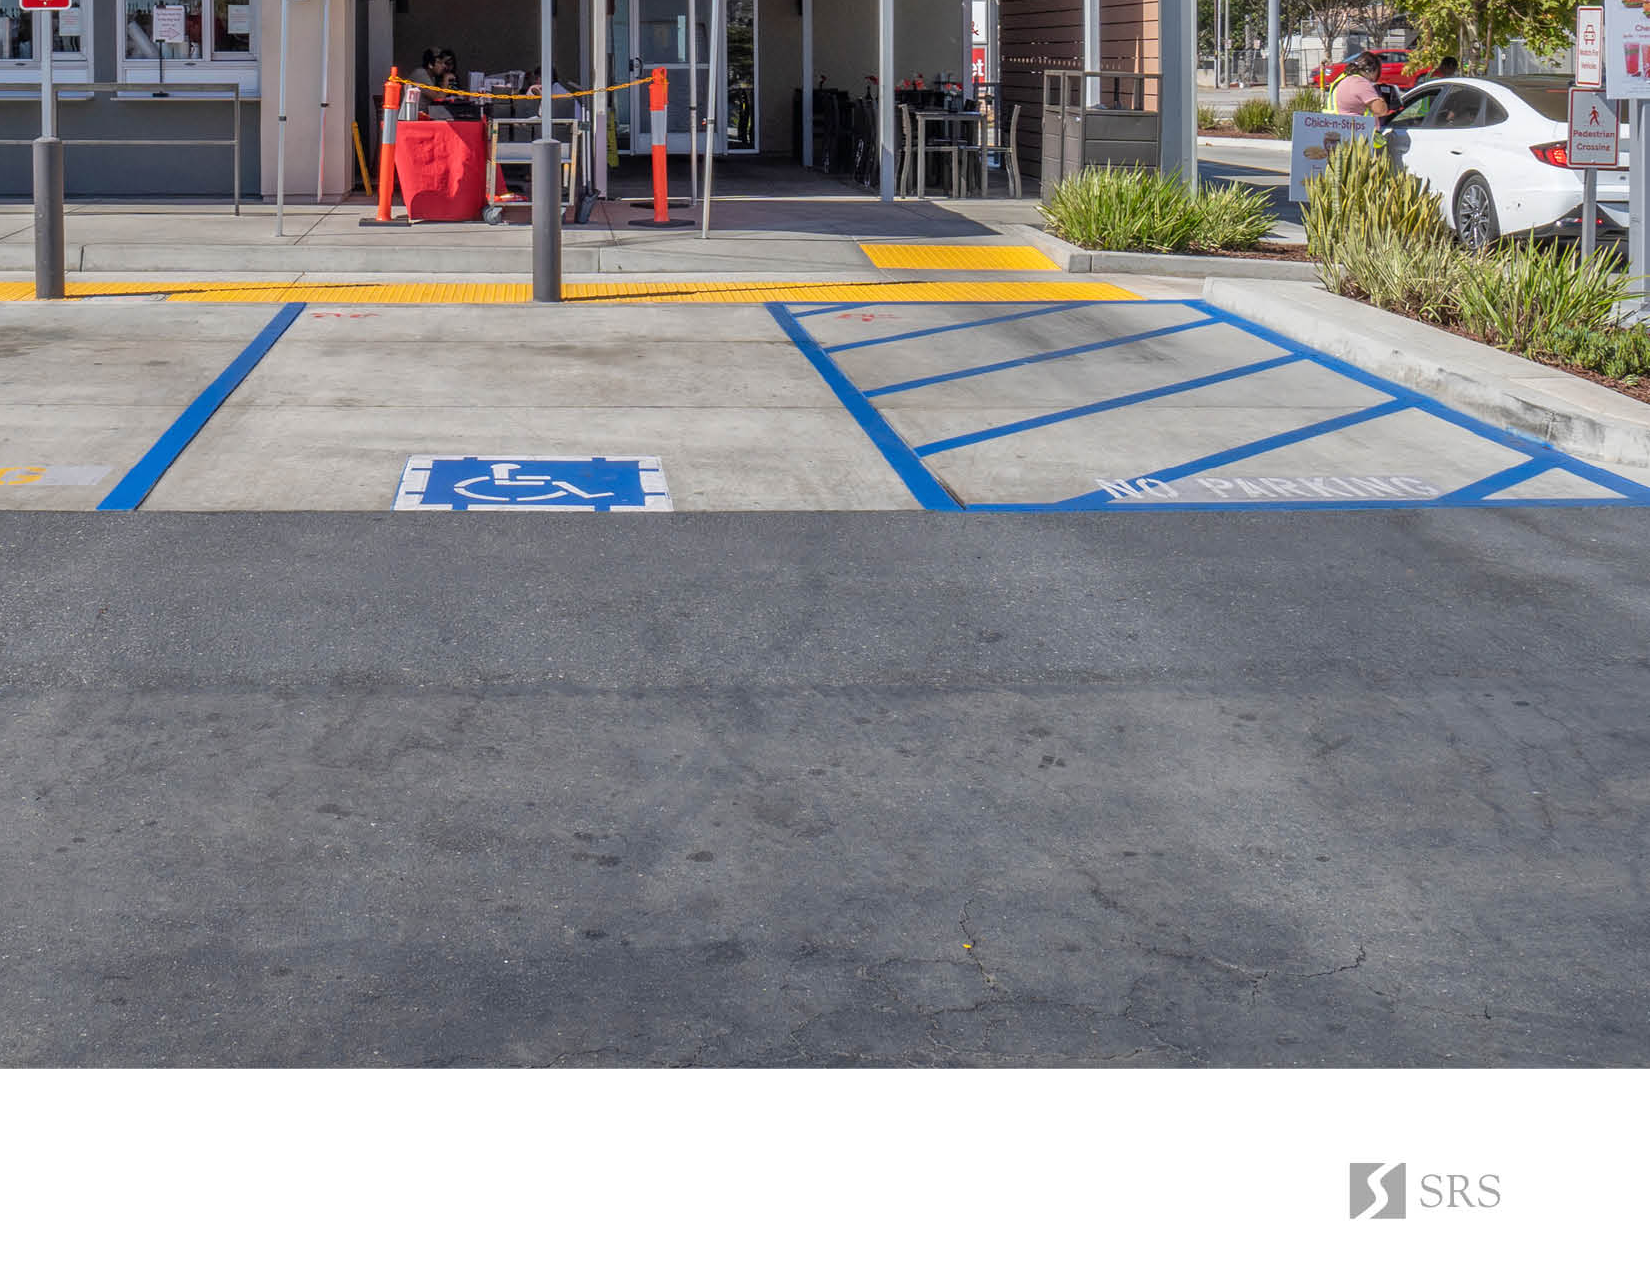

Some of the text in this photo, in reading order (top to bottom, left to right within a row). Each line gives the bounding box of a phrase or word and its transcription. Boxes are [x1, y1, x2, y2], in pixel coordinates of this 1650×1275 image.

[1573, 129, 1615, 138] Pedestrian
[1576, 143, 1610, 152] Crossing
[1097, 477, 1439, 499] NO PARKING
